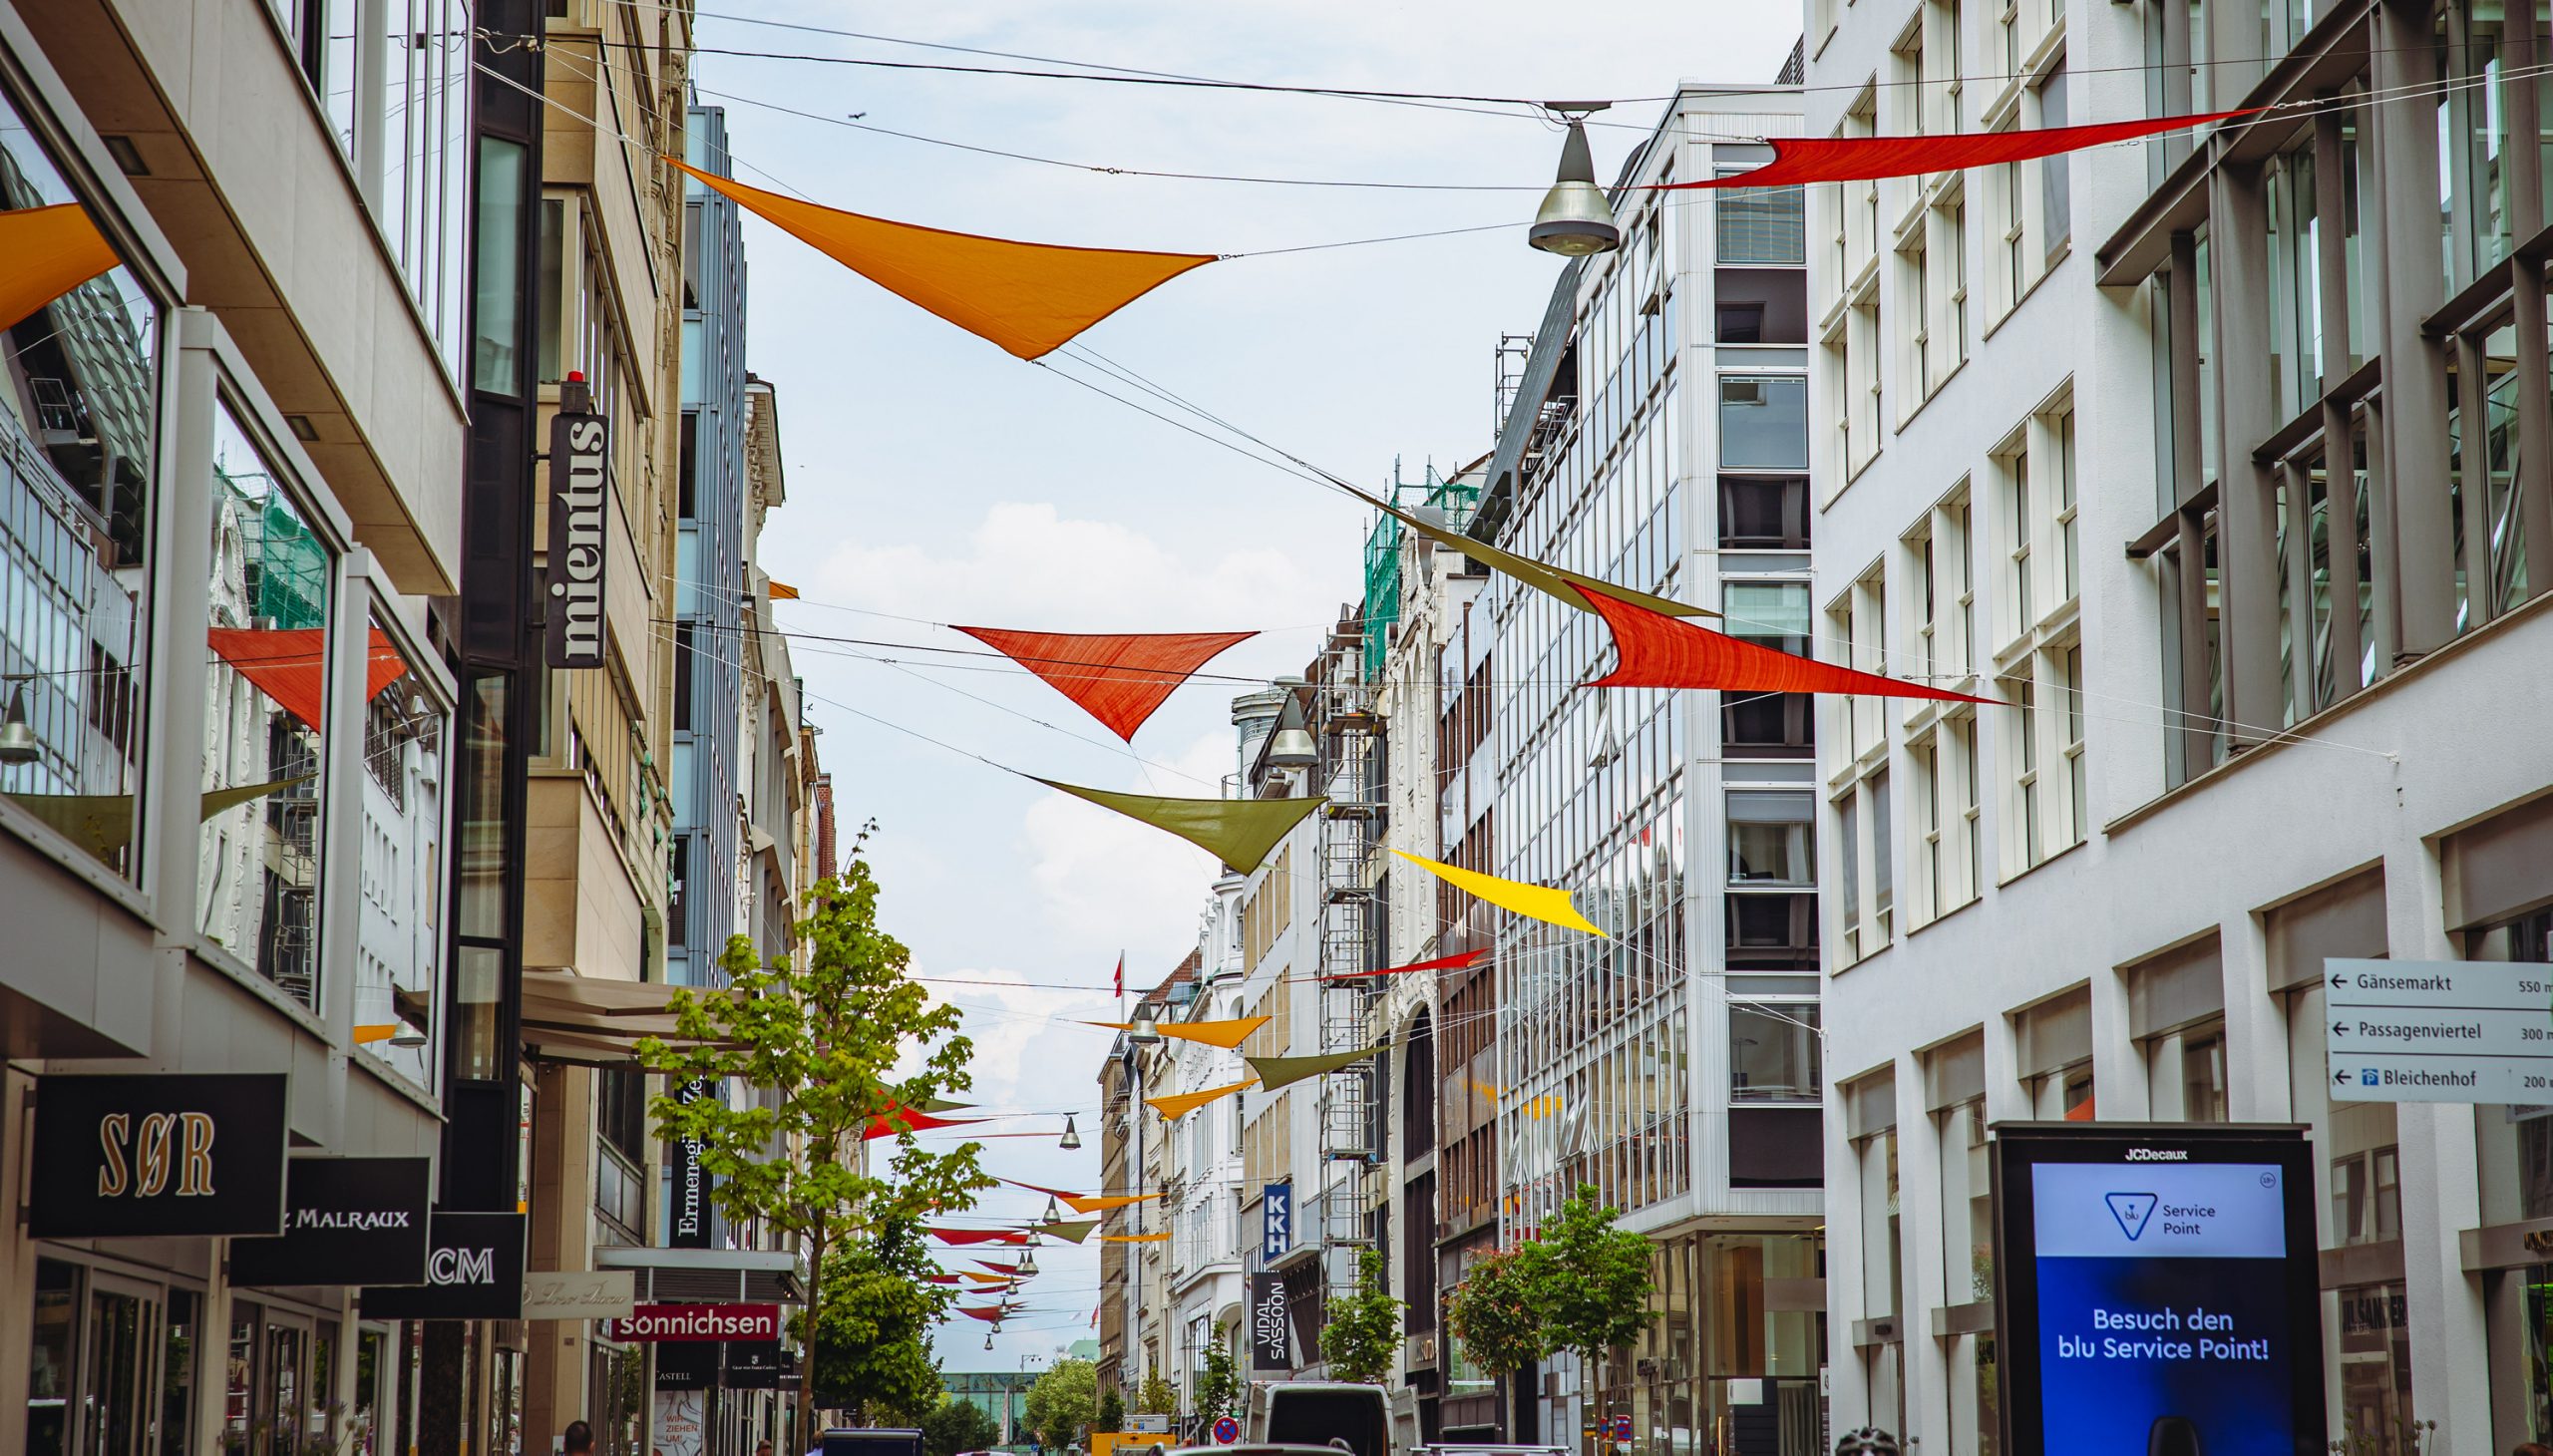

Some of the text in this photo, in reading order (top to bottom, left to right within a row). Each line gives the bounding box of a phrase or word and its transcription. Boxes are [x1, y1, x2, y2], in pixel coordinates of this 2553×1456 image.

[550, 421, 604, 659] mientus
[2357, 973, 2452, 991] Gänsemarkt
[2518, 980, 2541, 992] 550
[2360, 1021, 2481, 1041] Passagenviertel
[2521, 1028, 2543, 1040] 300
[2384, 1070, 2476, 1086] Bleichenhof
[2524, 1076, 2546, 1088] 200
[98, 1112, 215, 1198] SØR
[2125, 1148, 2188, 1161] JCDecaux
[2163, 1205, 2216, 1218] Service
[1268, 1196, 1286, 1254] KKH
[2163, 1223, 2201, 1235] Point
[427, 1247, 495, 1285] CM
[1257, 1296, 1271, 1345] VIDAL
[1271, 1282, 1284, 1359] SASSOON
[2093, 1306, 2233, 1330] Besuch den
[2058, 1334, 2269, 1360] blu Service Point!
[666, 1424, 698, 1433] ZIEHEN
